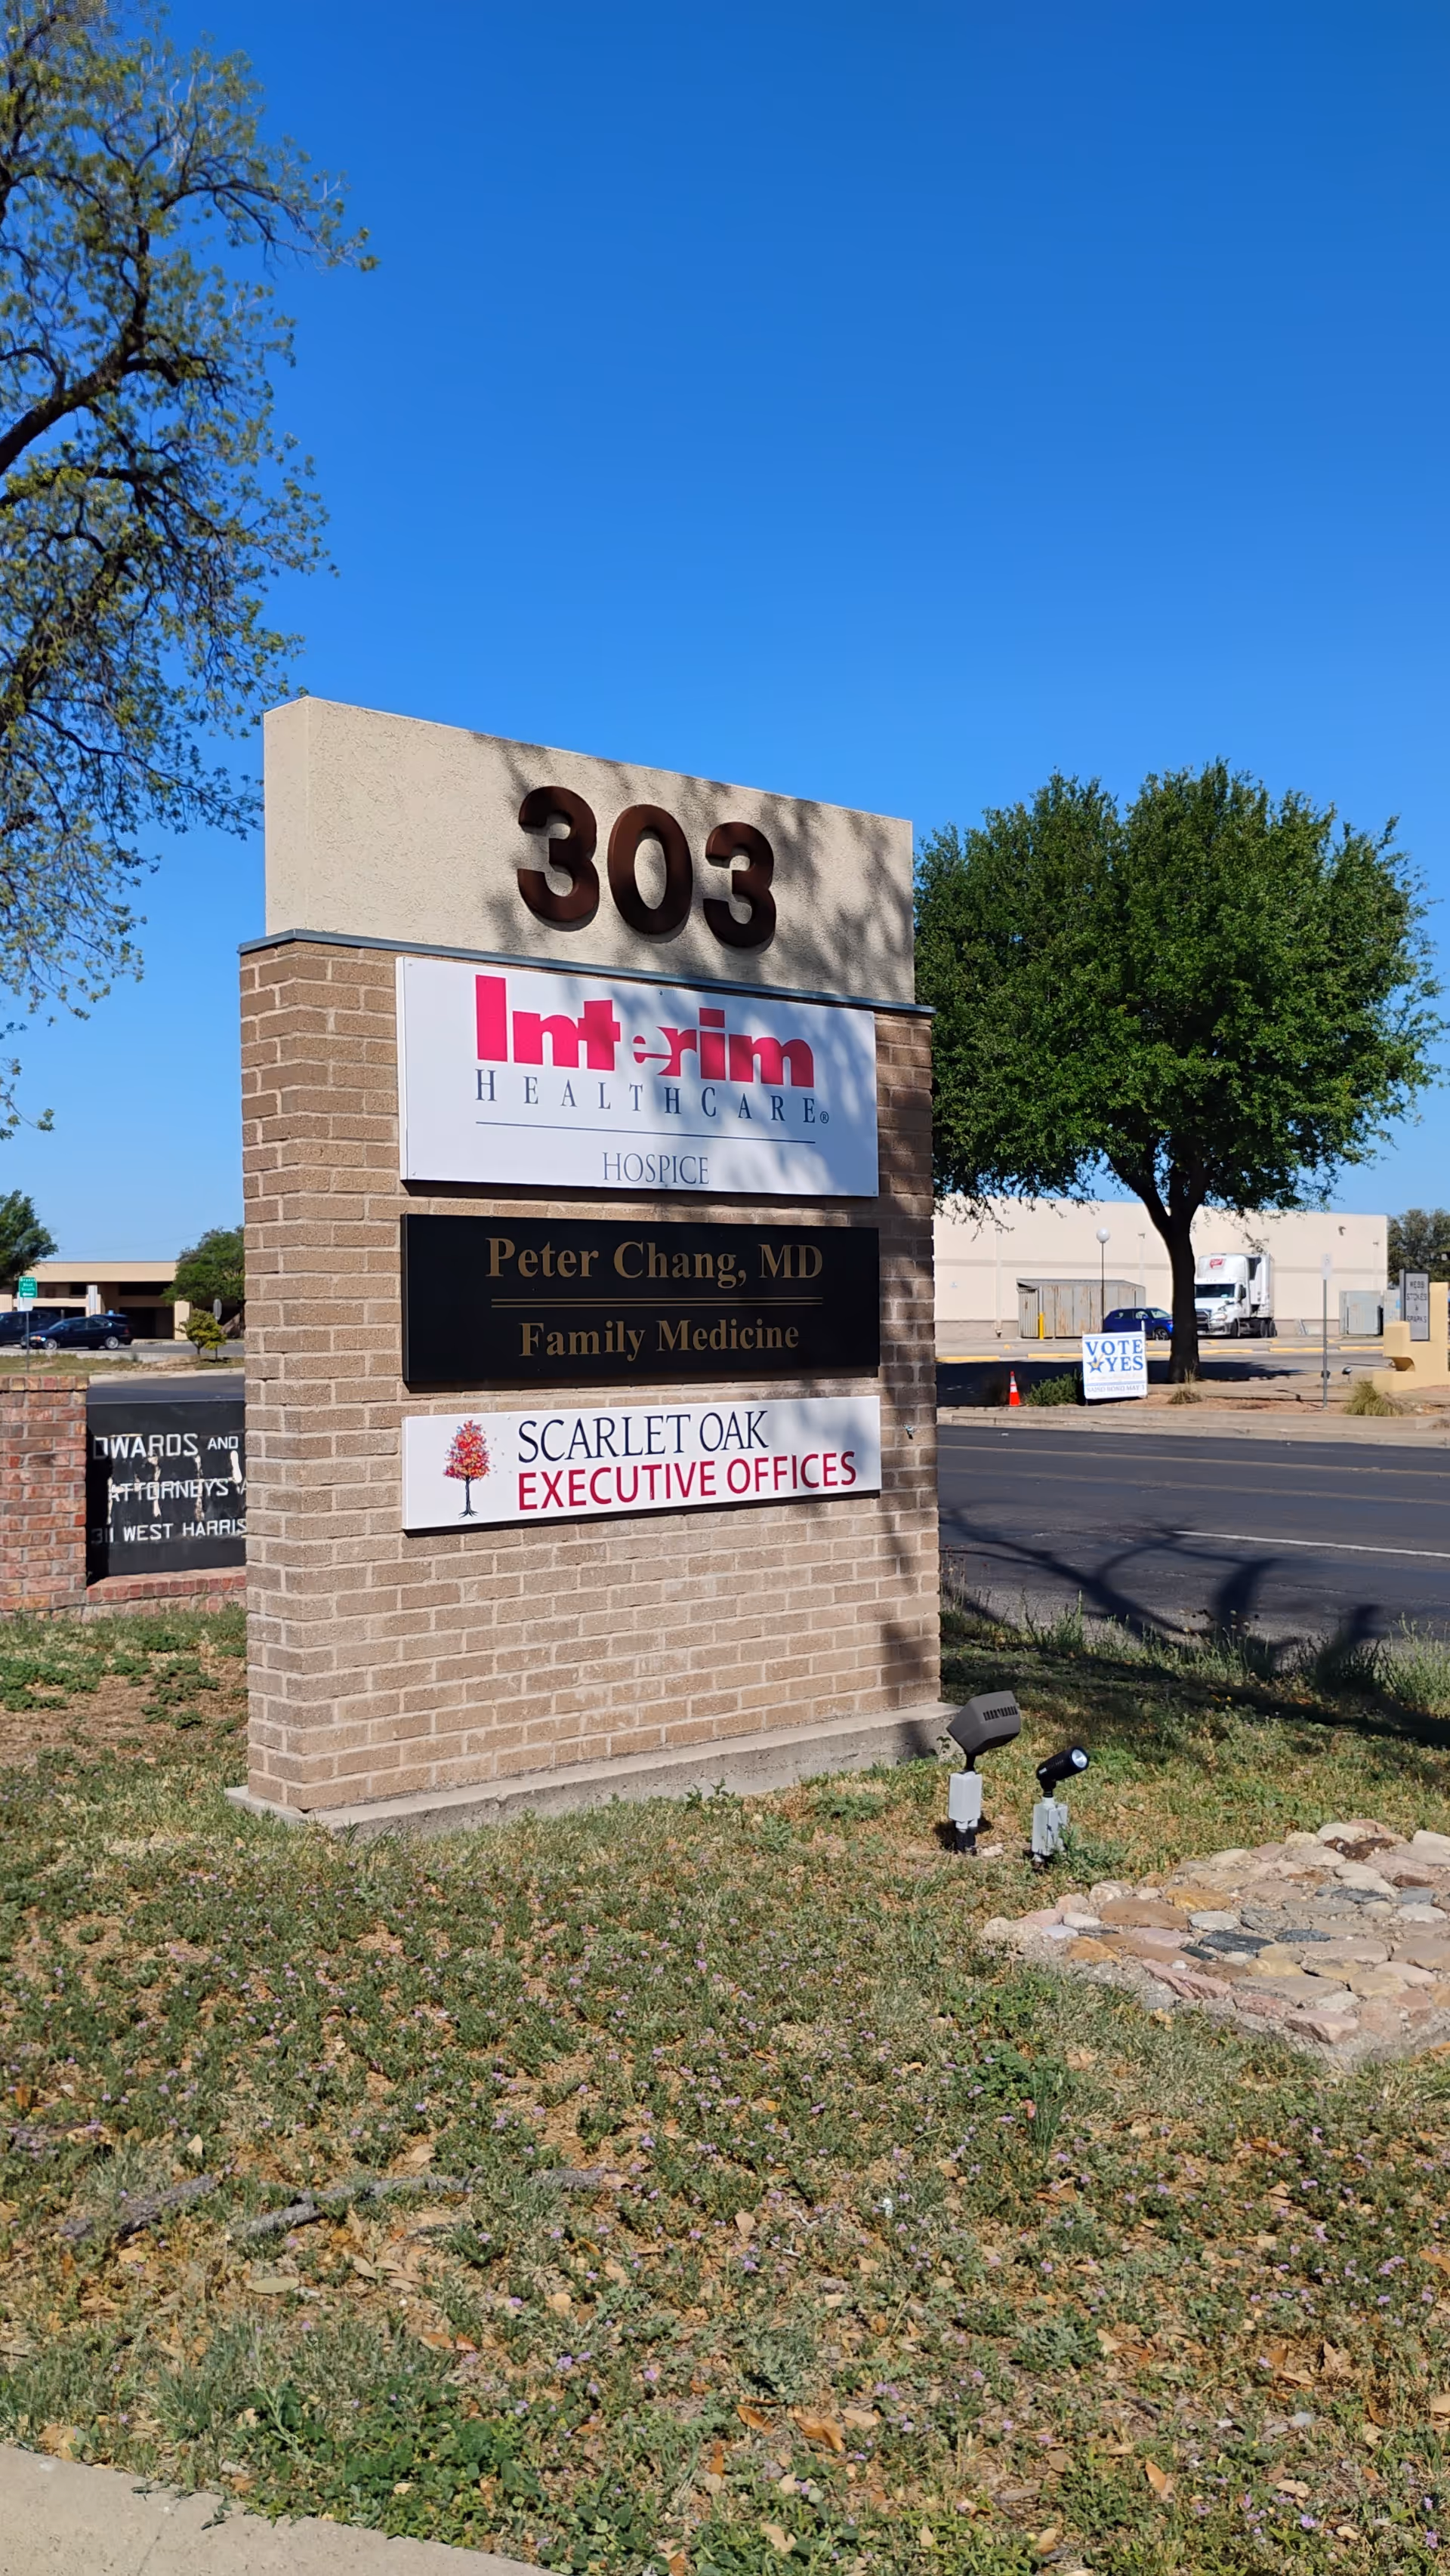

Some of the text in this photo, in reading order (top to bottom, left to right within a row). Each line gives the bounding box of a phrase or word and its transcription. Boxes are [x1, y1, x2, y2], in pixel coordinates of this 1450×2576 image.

[517, 785, 776, 948] 303
[475, 974, 814, 1088] Interim
[603, 1151, 710, 1185] HOSPICE
[485, 1237, 824, 1290] Peter Chang, MD
[519, 1317, 800, 1362] Family Medicine
[1084, 1339, 1143, 1356] VOTE
[1105, 1355, 1143, 1373] YES
[207, 1435, 239, 1450] AND
[518, 1410, 769, 1463] SCARLET OAK
[109, 1478, 229, 1502] ATTORNEYS
[518, 1450, 857, 1511] EXECUTIVE OFFICES
[123, 1523, 174, 1542] WEST
